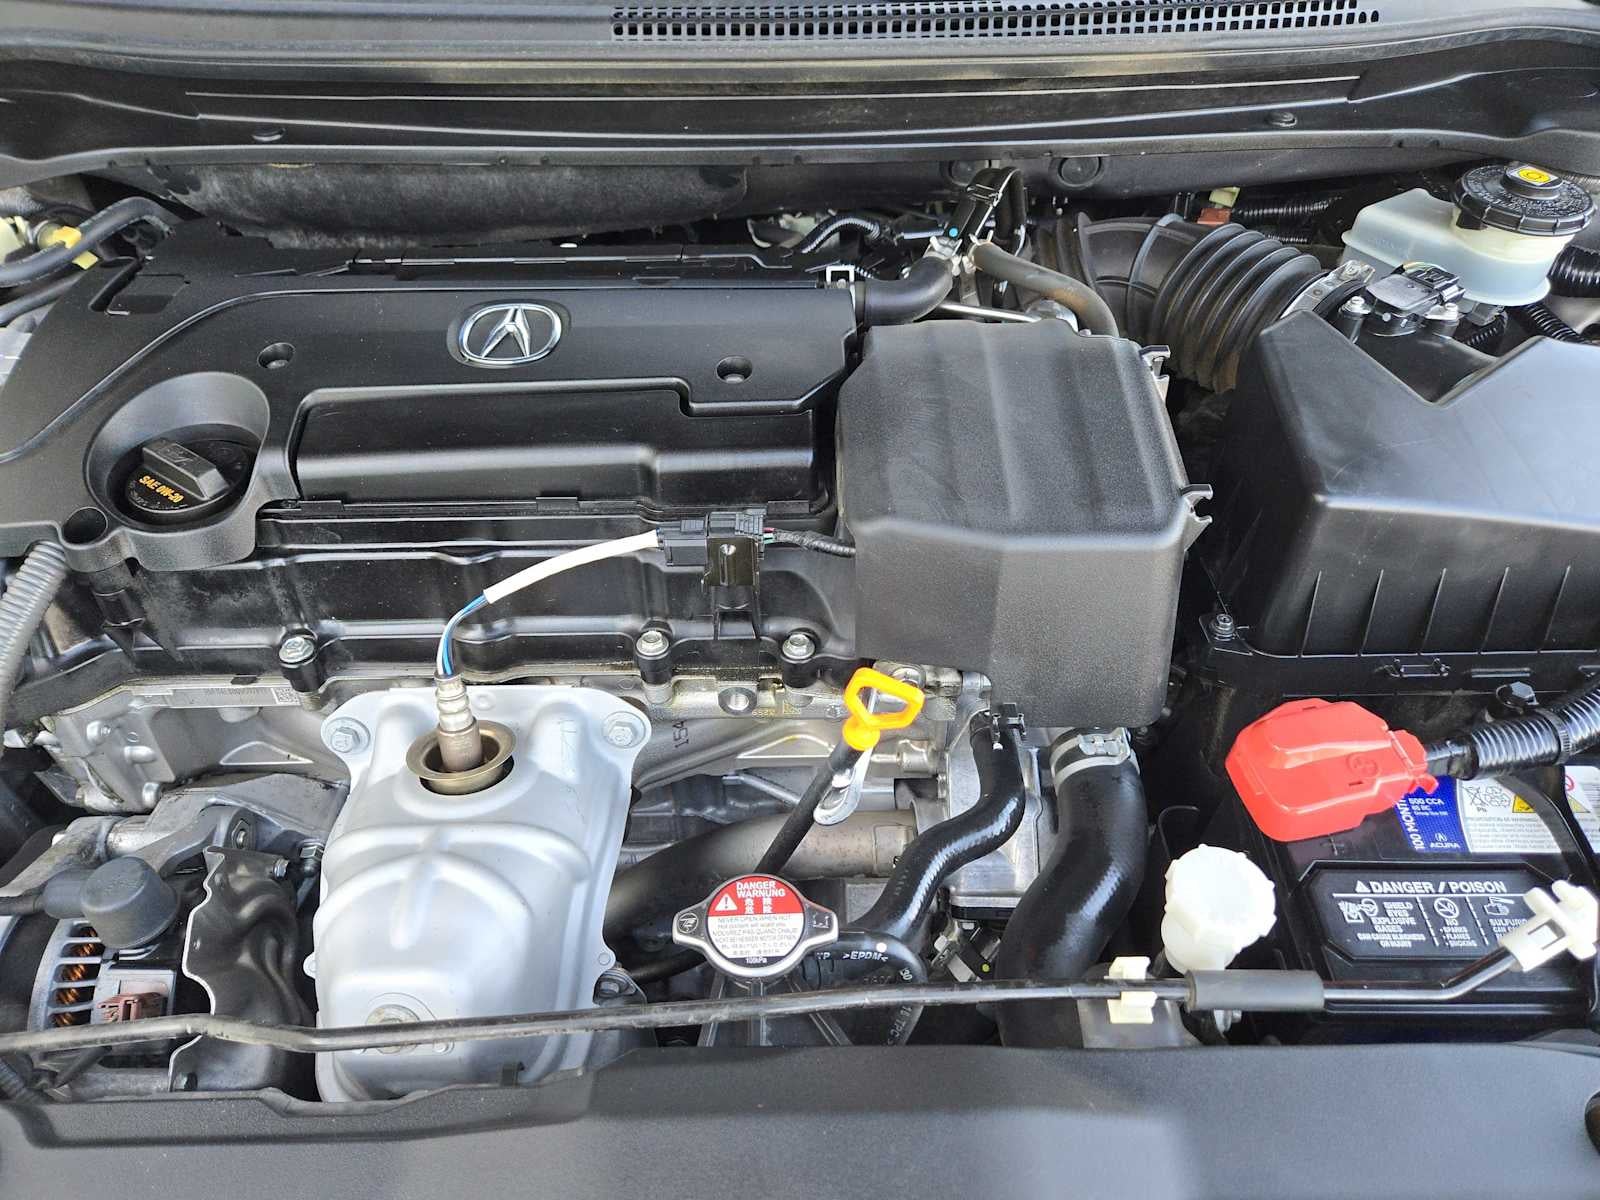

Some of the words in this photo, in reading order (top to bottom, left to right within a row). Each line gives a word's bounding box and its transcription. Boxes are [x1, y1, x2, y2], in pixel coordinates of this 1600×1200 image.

[139, 475, 161, 490] SAE
[156, 485, 185, 503] 0W-20
[1426, 797, 1445, 806] CCA
[1410, 833, 1426, 851] 100
[736, 880, 776, 890] DANGER
[1369, 881, 1436, 894] DANGER
[1438, 880, 1446, 894] /
[1447, 880, 1508, 893] POISON
[736, 888, 786, 899] WARNUNG
[1383, 901, 1414, 910] SHIELD
[1386, 909, 1410, 917] EYES
[1370, 916, 1417, 925] EXPLOSIVE
[1445, 918, 1459, 926] NO
[1374, 924, 1404, 933] GASES
